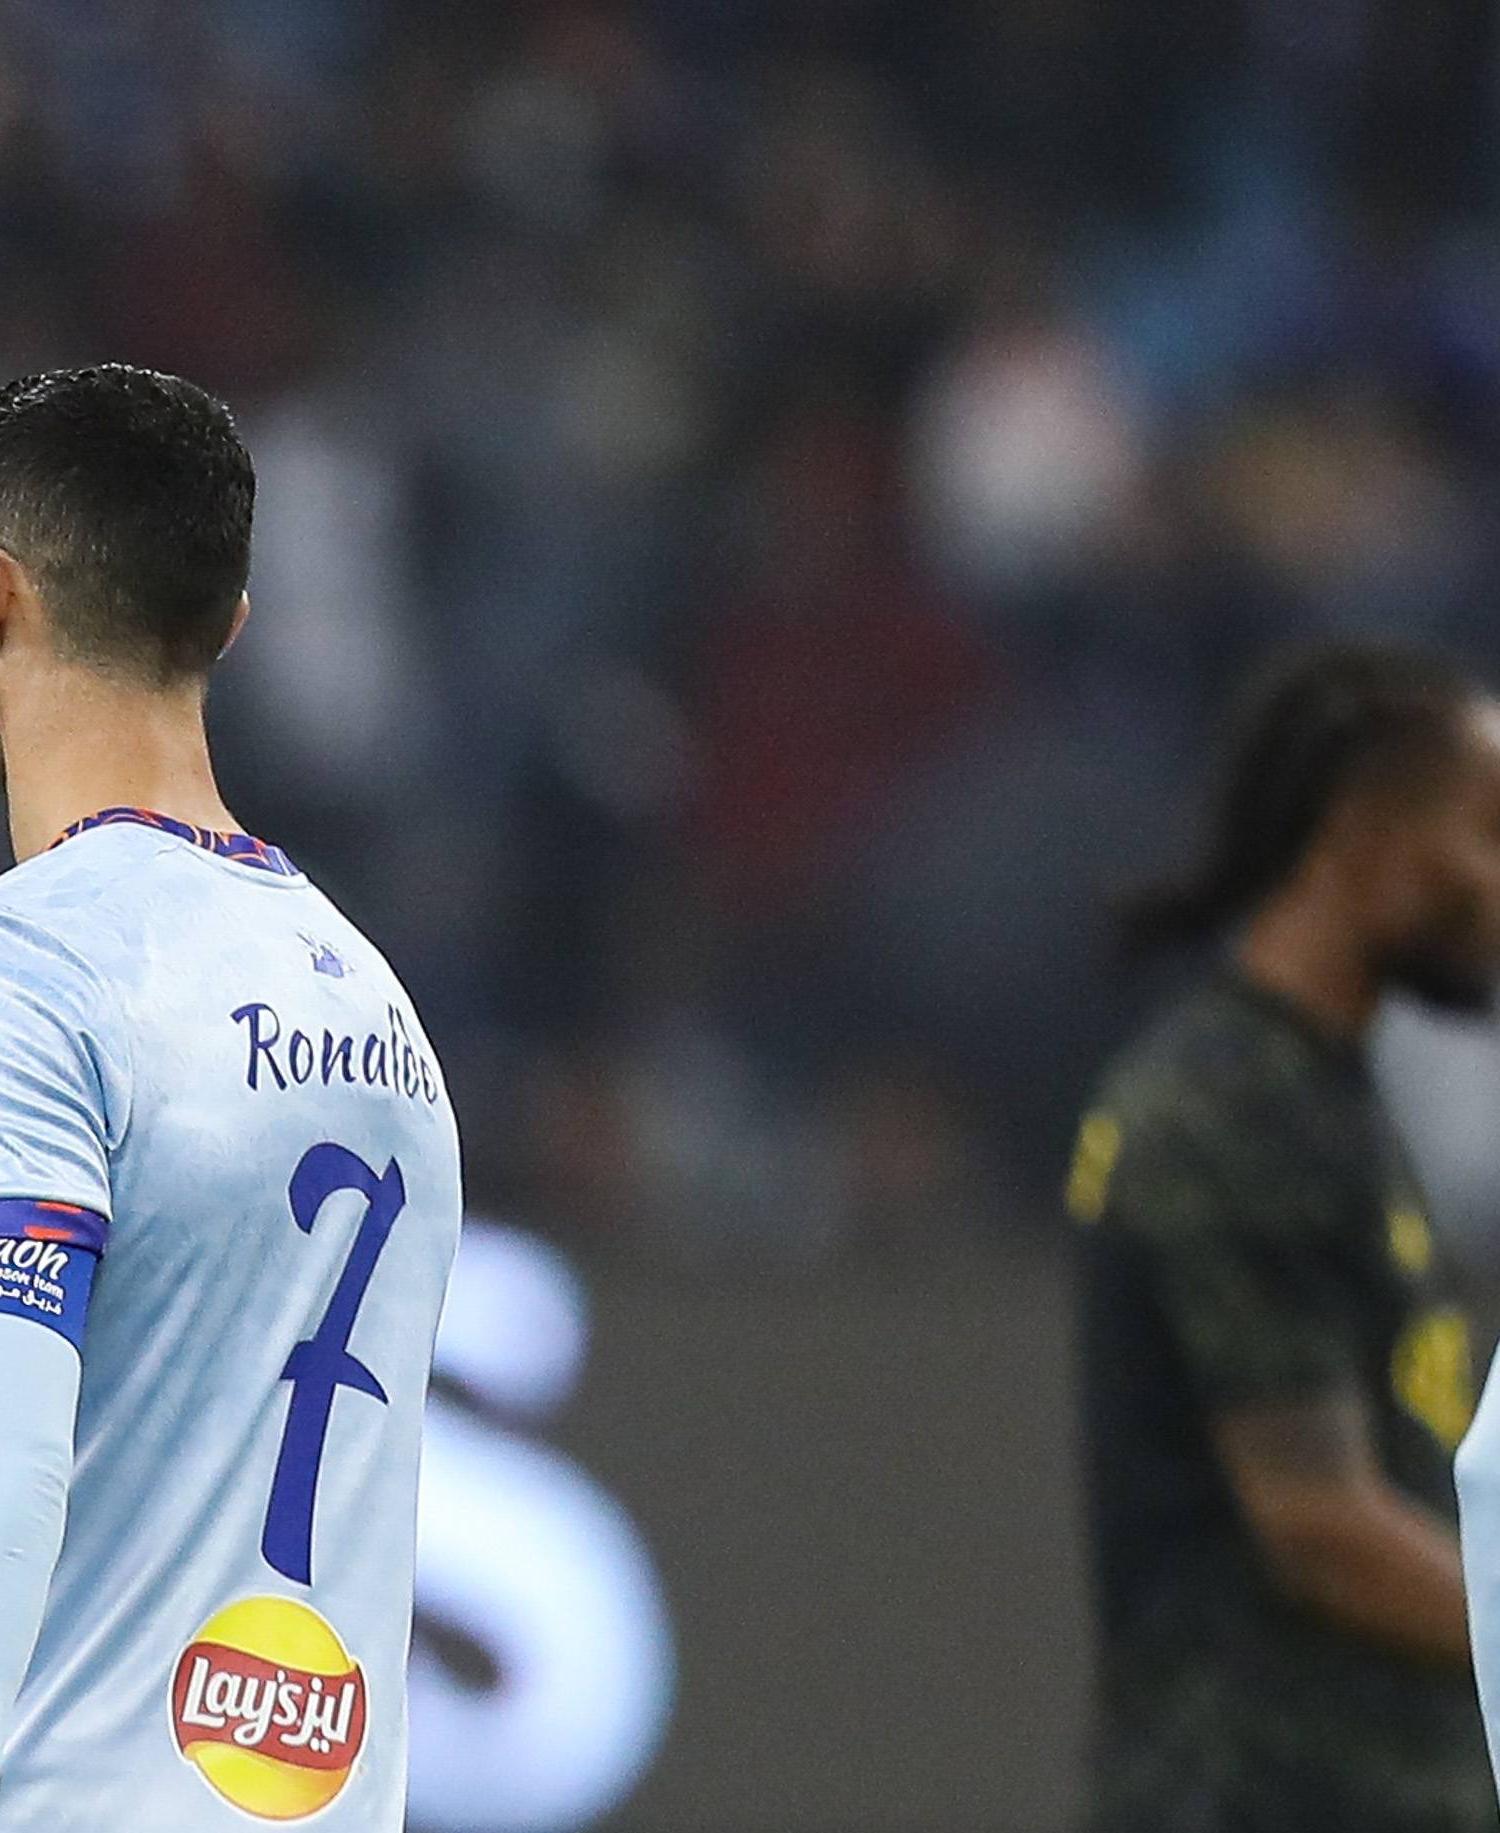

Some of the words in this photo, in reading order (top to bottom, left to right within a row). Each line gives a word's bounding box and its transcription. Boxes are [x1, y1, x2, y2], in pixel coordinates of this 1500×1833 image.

[230, 1002, 438, 1105] Ronaldo
[259, 1141, 406, 1588] 7
[181, 1656, 304, 1746] Lay's
